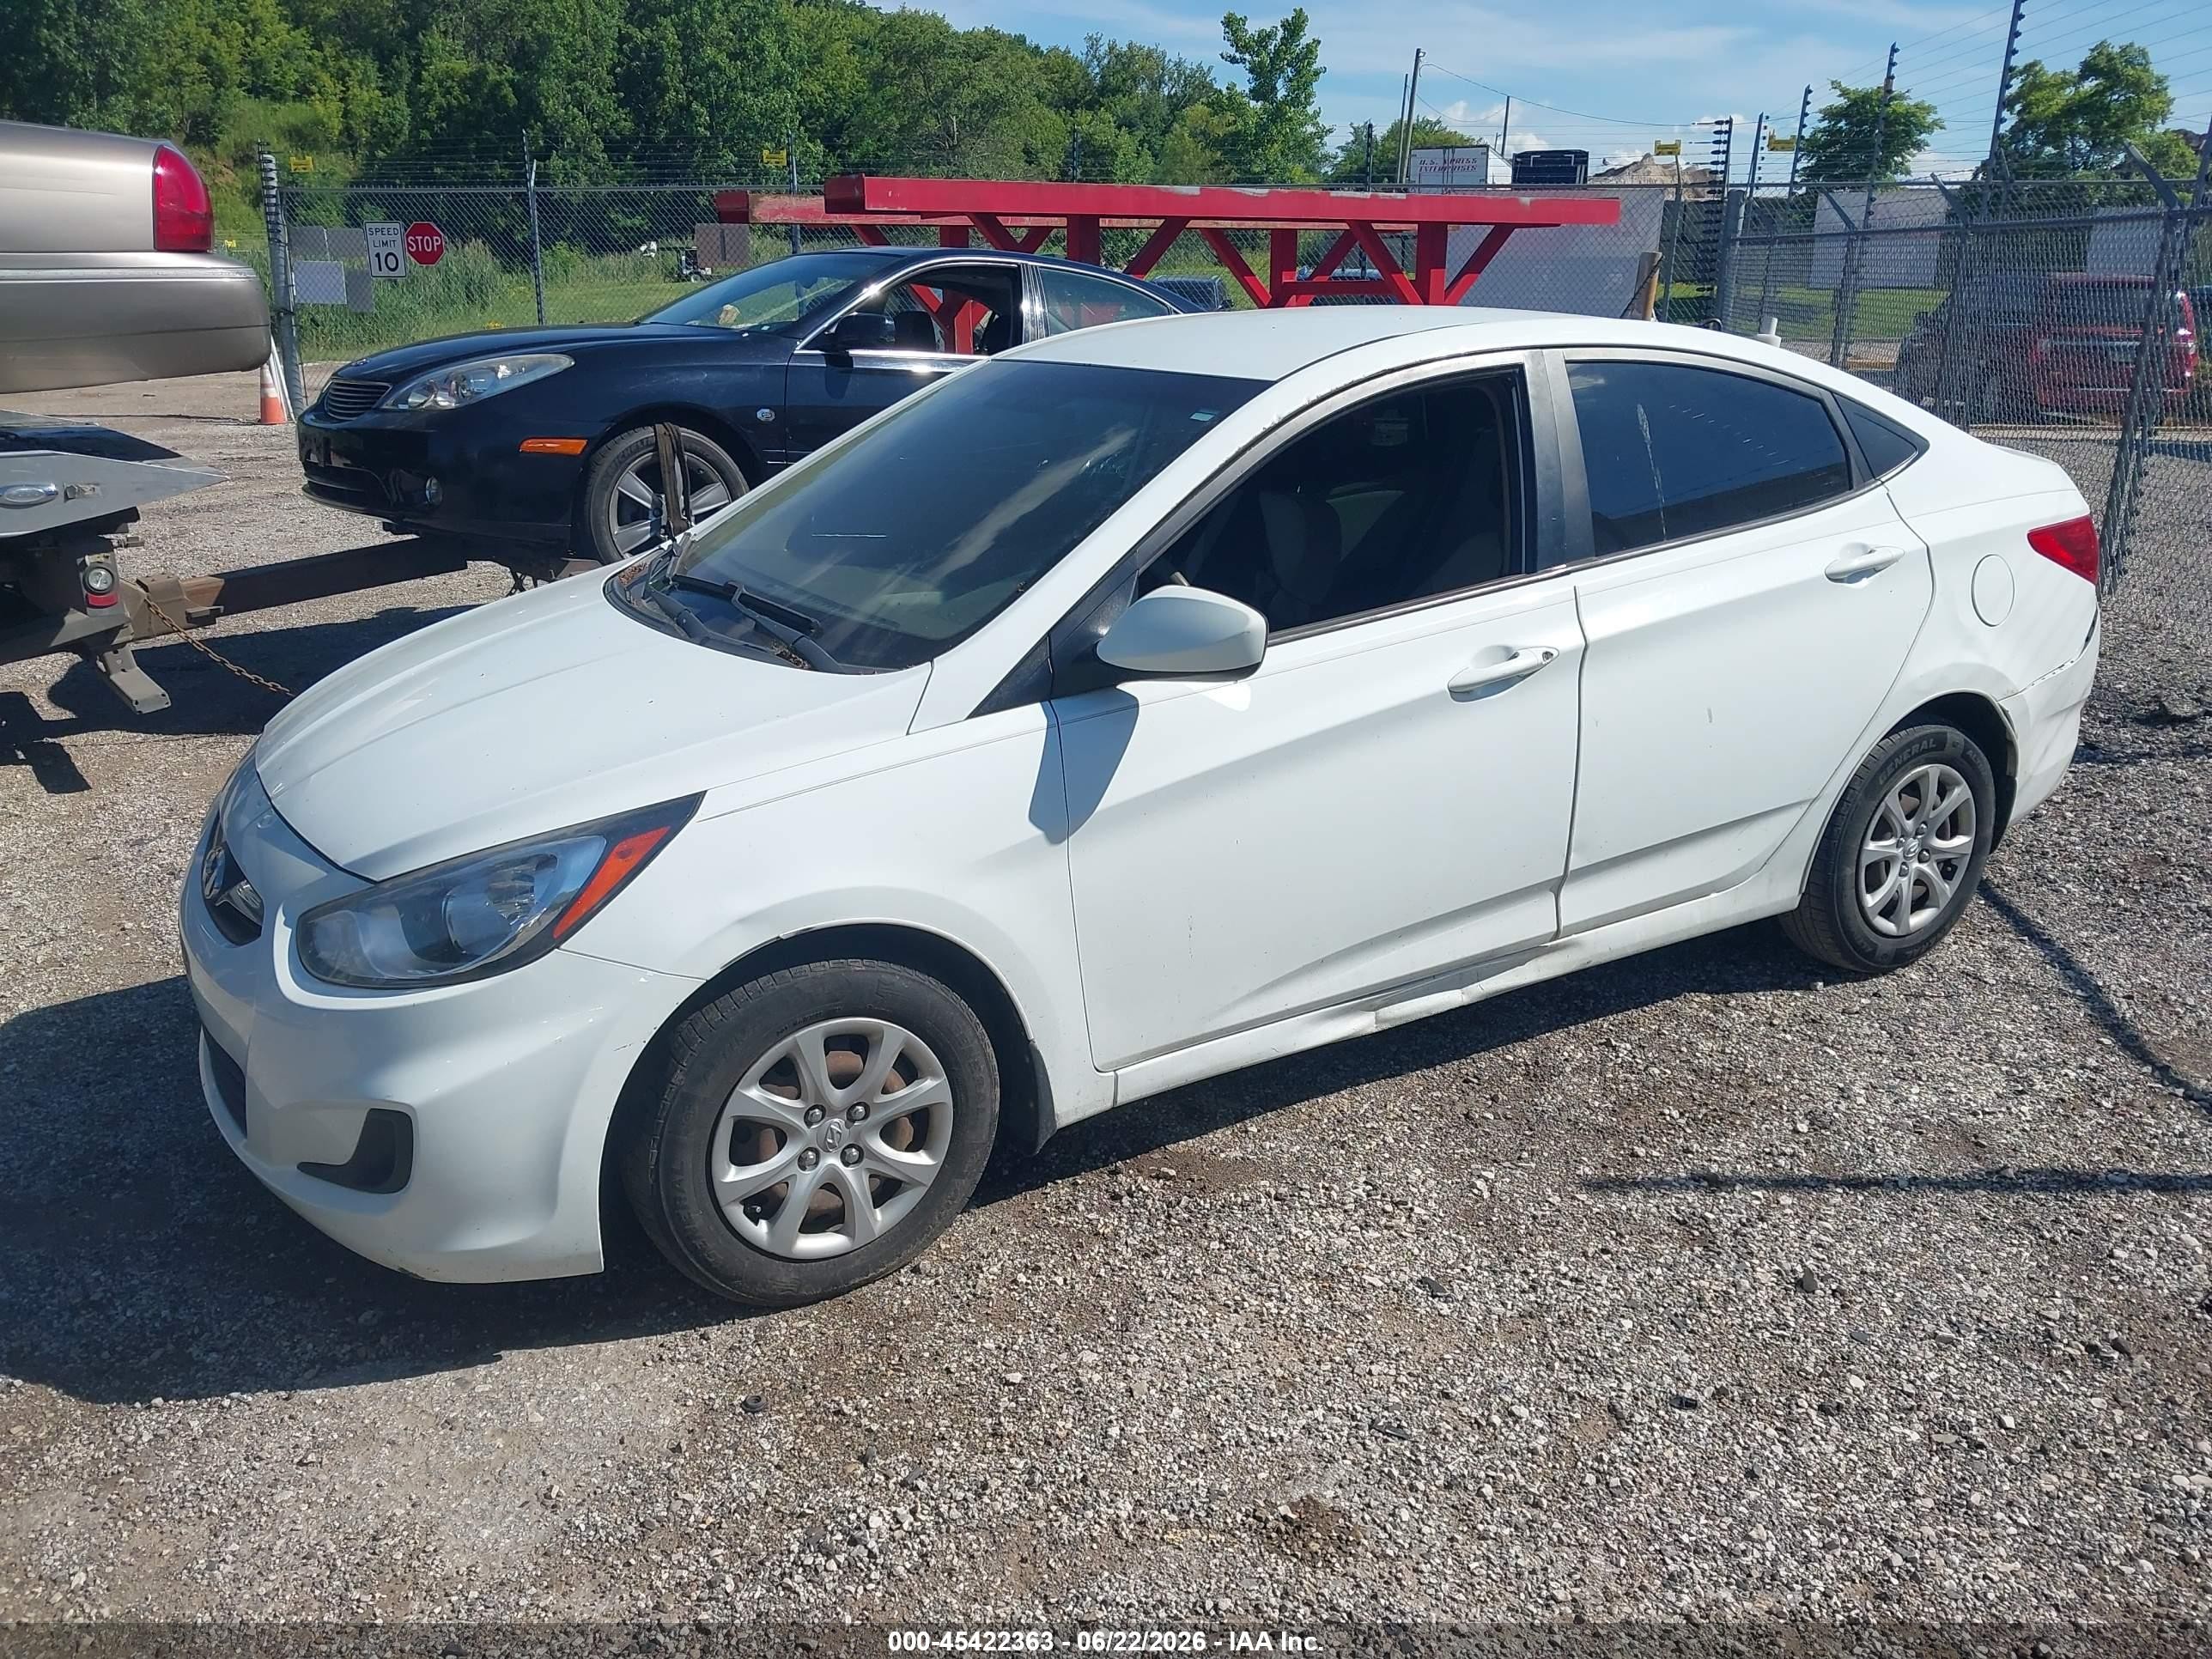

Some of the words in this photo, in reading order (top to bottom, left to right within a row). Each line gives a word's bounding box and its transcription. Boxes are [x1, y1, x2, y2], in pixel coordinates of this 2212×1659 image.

[368, 227, 399, 236] SPEED
[373, 240, 398, 248] LIMIT
[407, 235, 441, 252] STOP
[374, 252, 399, 272] 10
[1878, 738, 1937, 785] GENERAL
